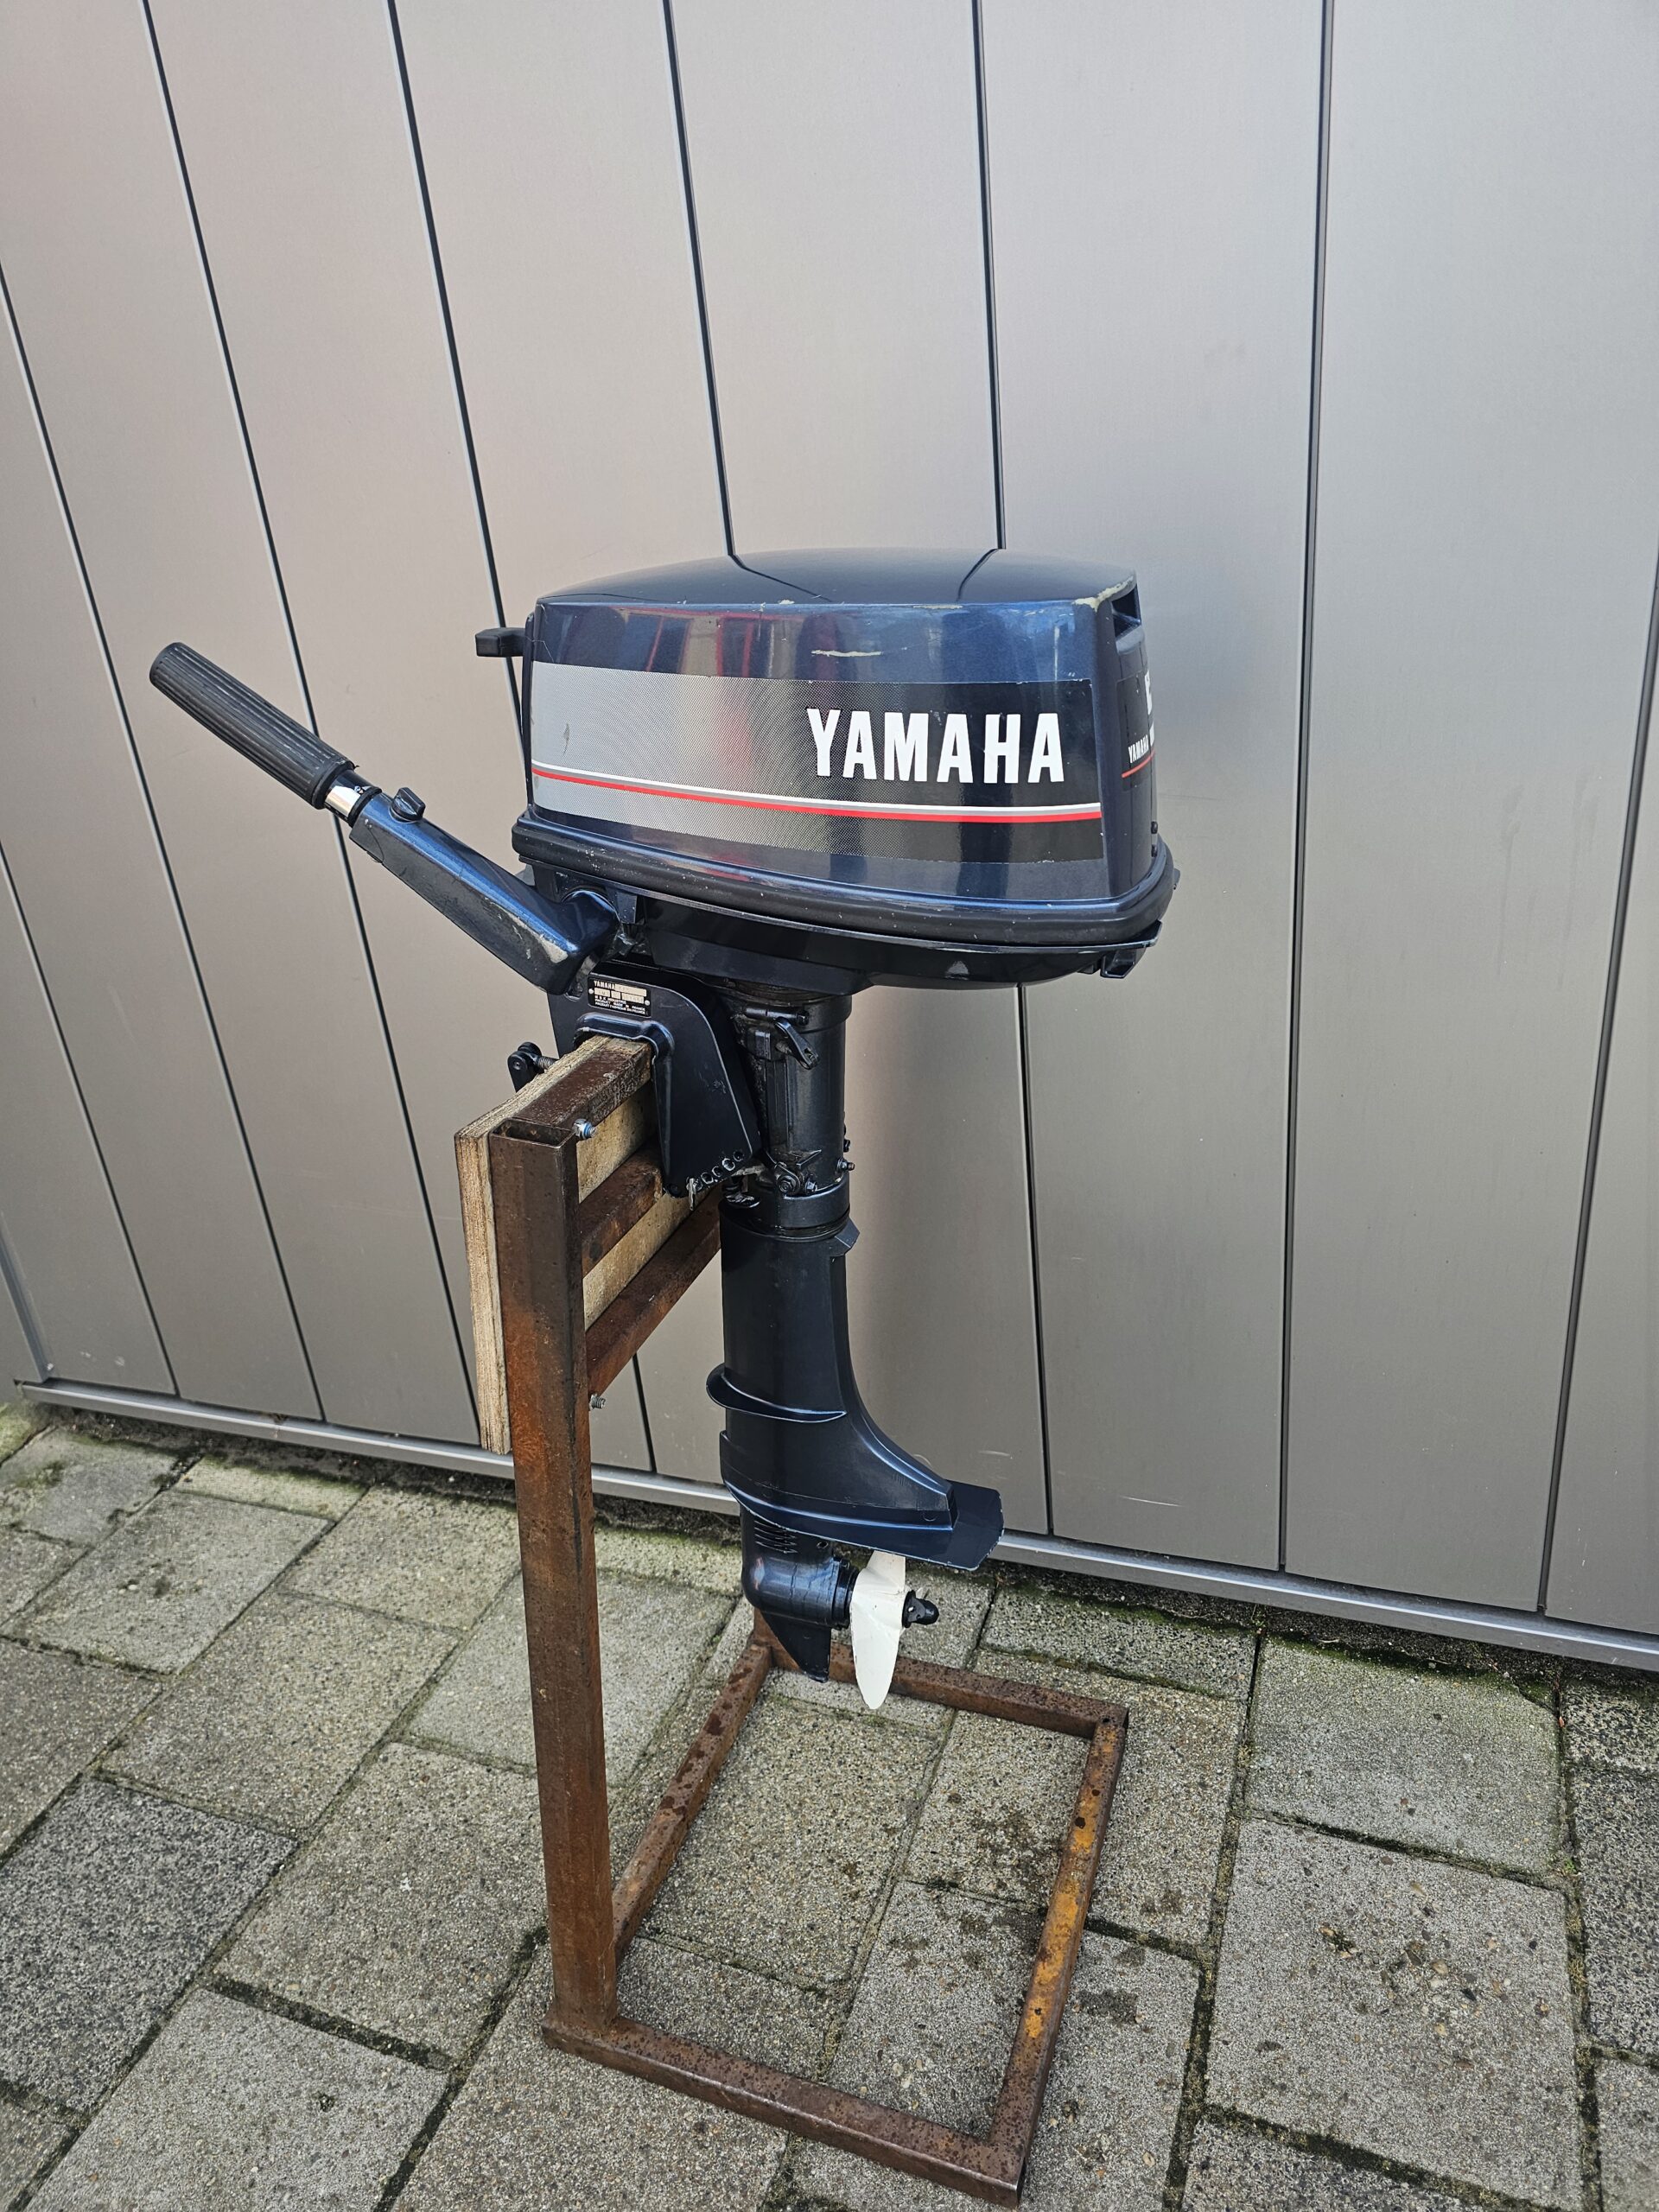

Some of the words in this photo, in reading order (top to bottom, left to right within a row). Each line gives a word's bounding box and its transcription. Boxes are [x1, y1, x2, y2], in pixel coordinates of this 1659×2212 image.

[806, 708, 1065, 784] YAMAHA
[1128, 734, 1149, 763] YAMAHA
[594, 980, 615, 990] YAMAHA
